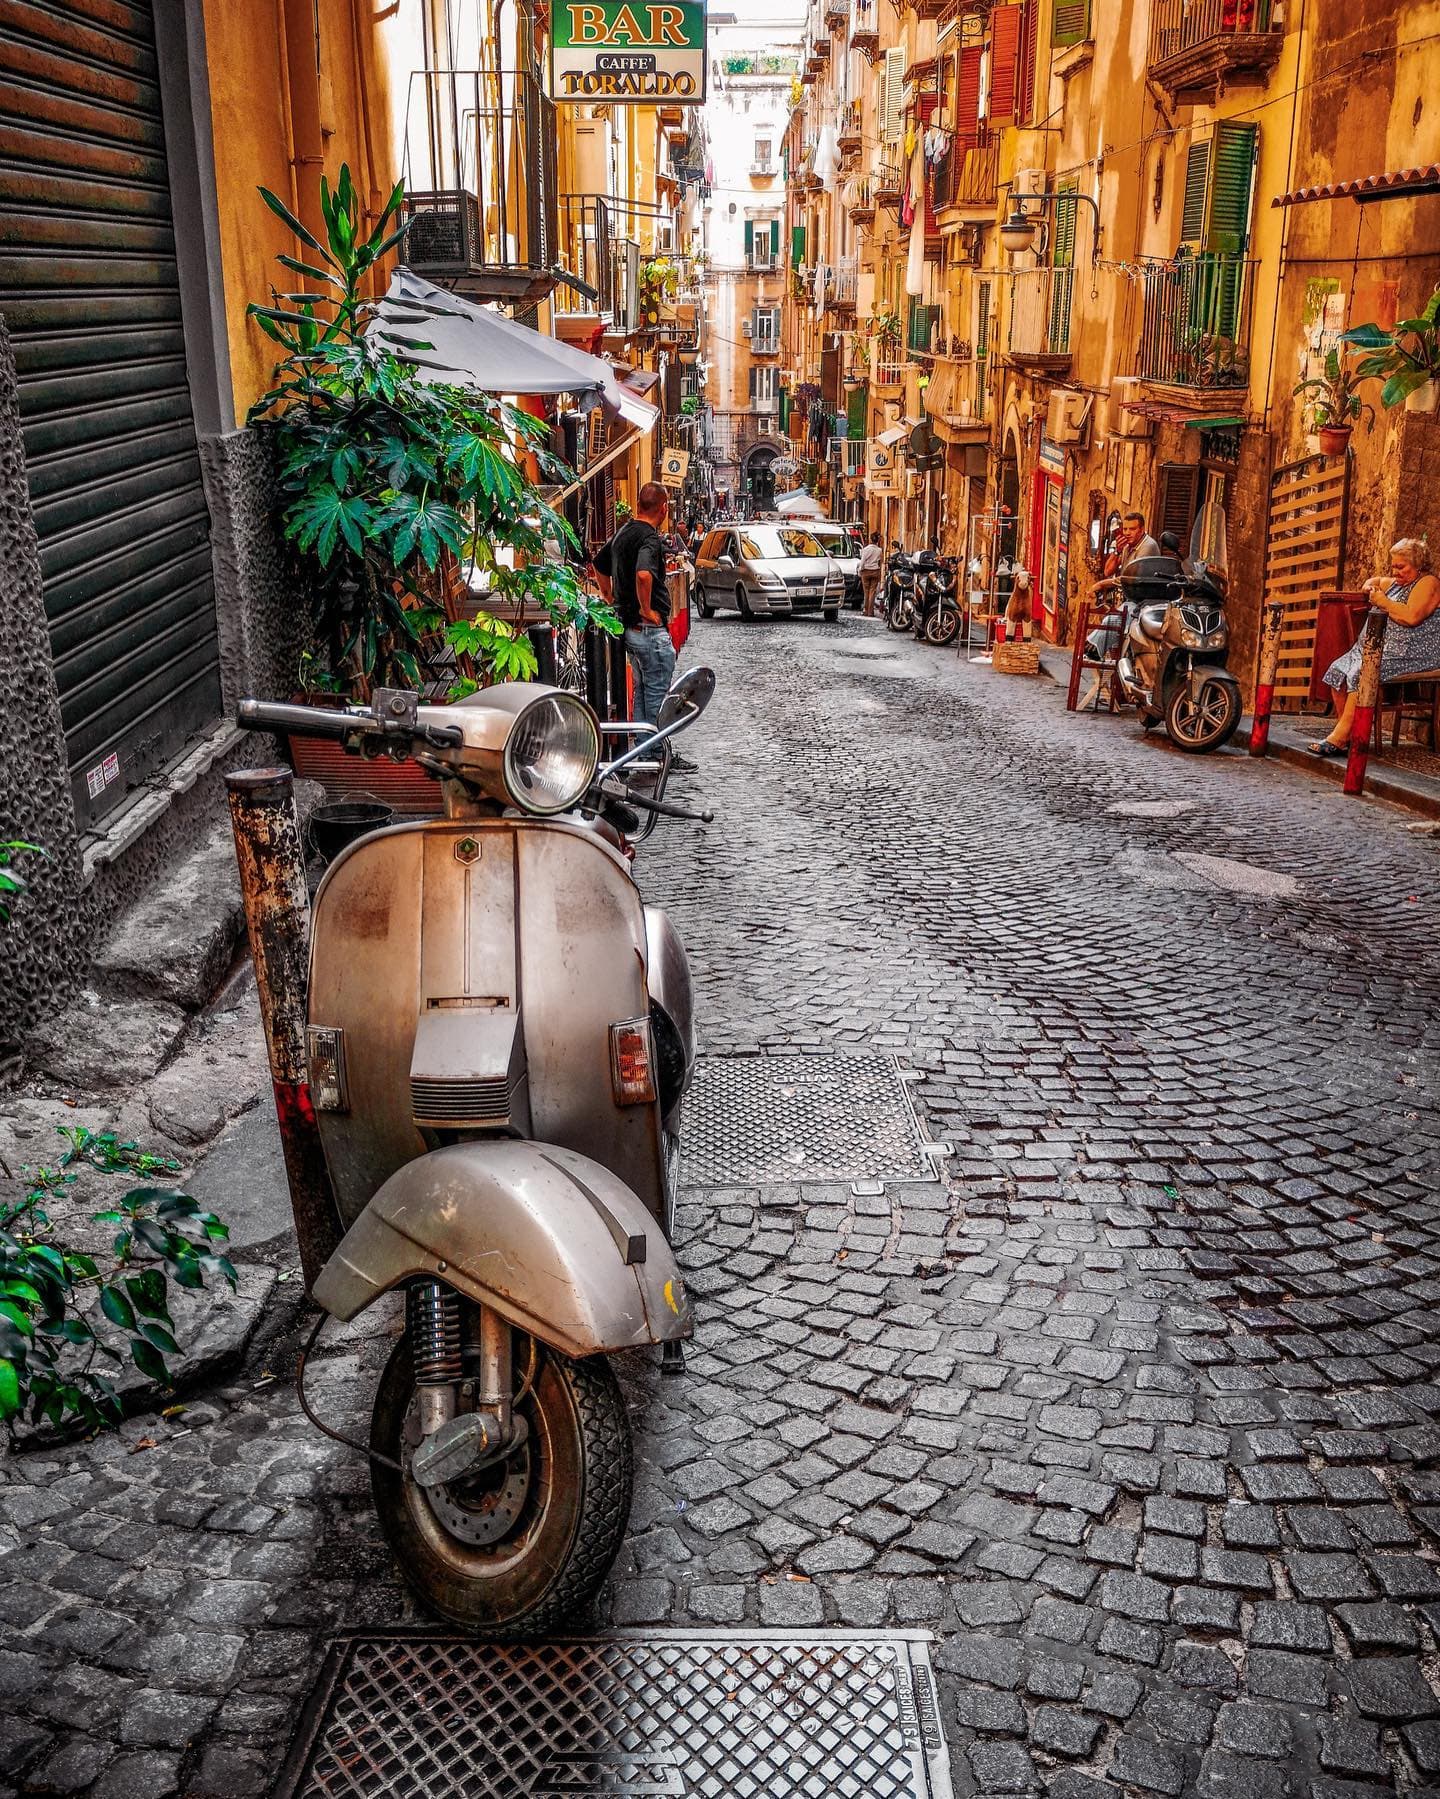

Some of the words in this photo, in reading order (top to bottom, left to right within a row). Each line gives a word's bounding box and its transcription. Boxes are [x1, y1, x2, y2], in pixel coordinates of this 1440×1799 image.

[568, 4, 690, 45] BAR
[599, 57, 653, 70] CAFFE'
[560, 70, 697, 96] TORALDO
[772, 1074, 837, 1084] WIND
[899, 1688, 916, 1721] SAICES
[903, 1728, 919, 1747] 79
[924, 1725, 940, 1745] 79
